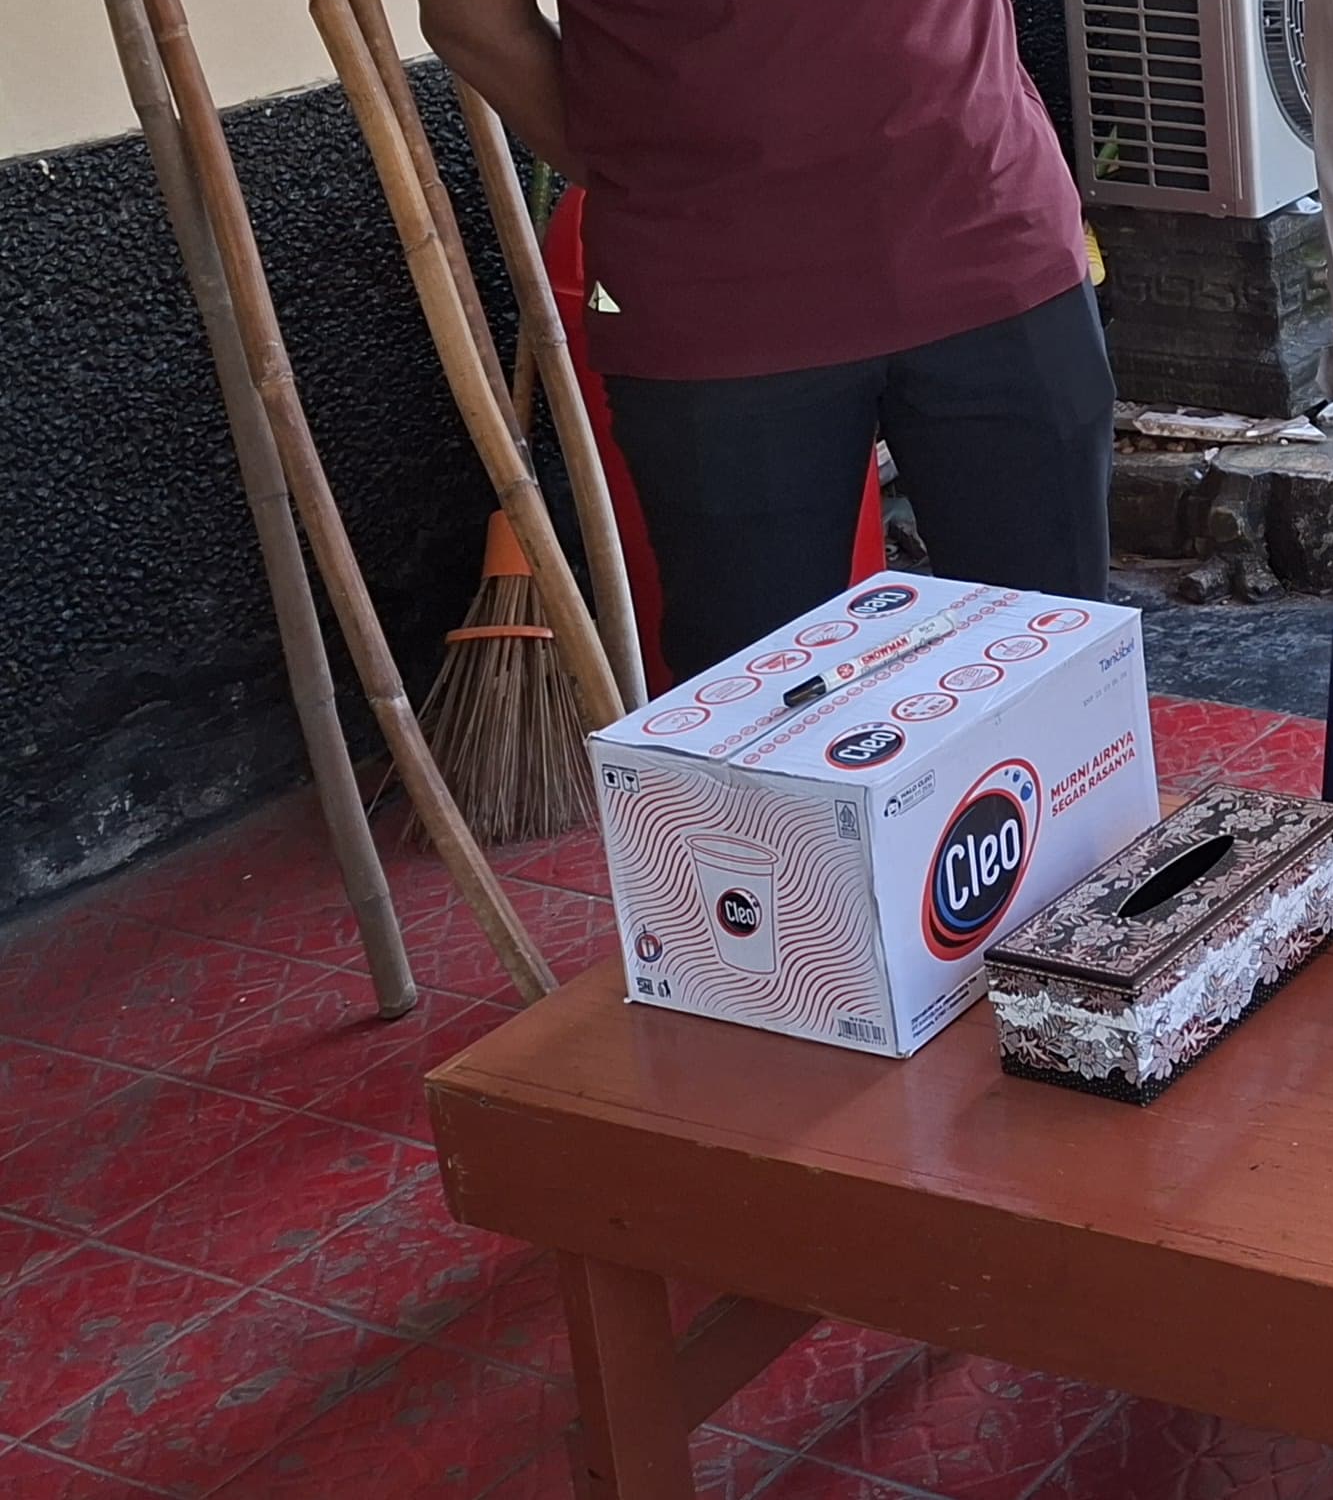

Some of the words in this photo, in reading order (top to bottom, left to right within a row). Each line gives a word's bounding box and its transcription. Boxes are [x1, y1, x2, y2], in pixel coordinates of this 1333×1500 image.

[854, 591, 907, 614] Cleo
[860, 636, 910, 665] SNOWMAN
[838, 732, 897, 760] Cleo
[1050, 762, 1090, 802] MURNI
[1091, 731, 1135, 773] AIRNYA
[1051, 781, 1087, 818] SEGAR
[1089, 747, 1136, 792] RASANYA
[945, 819, 1021, 911] Cleo
[725, 900, 756, 926] Cleo
